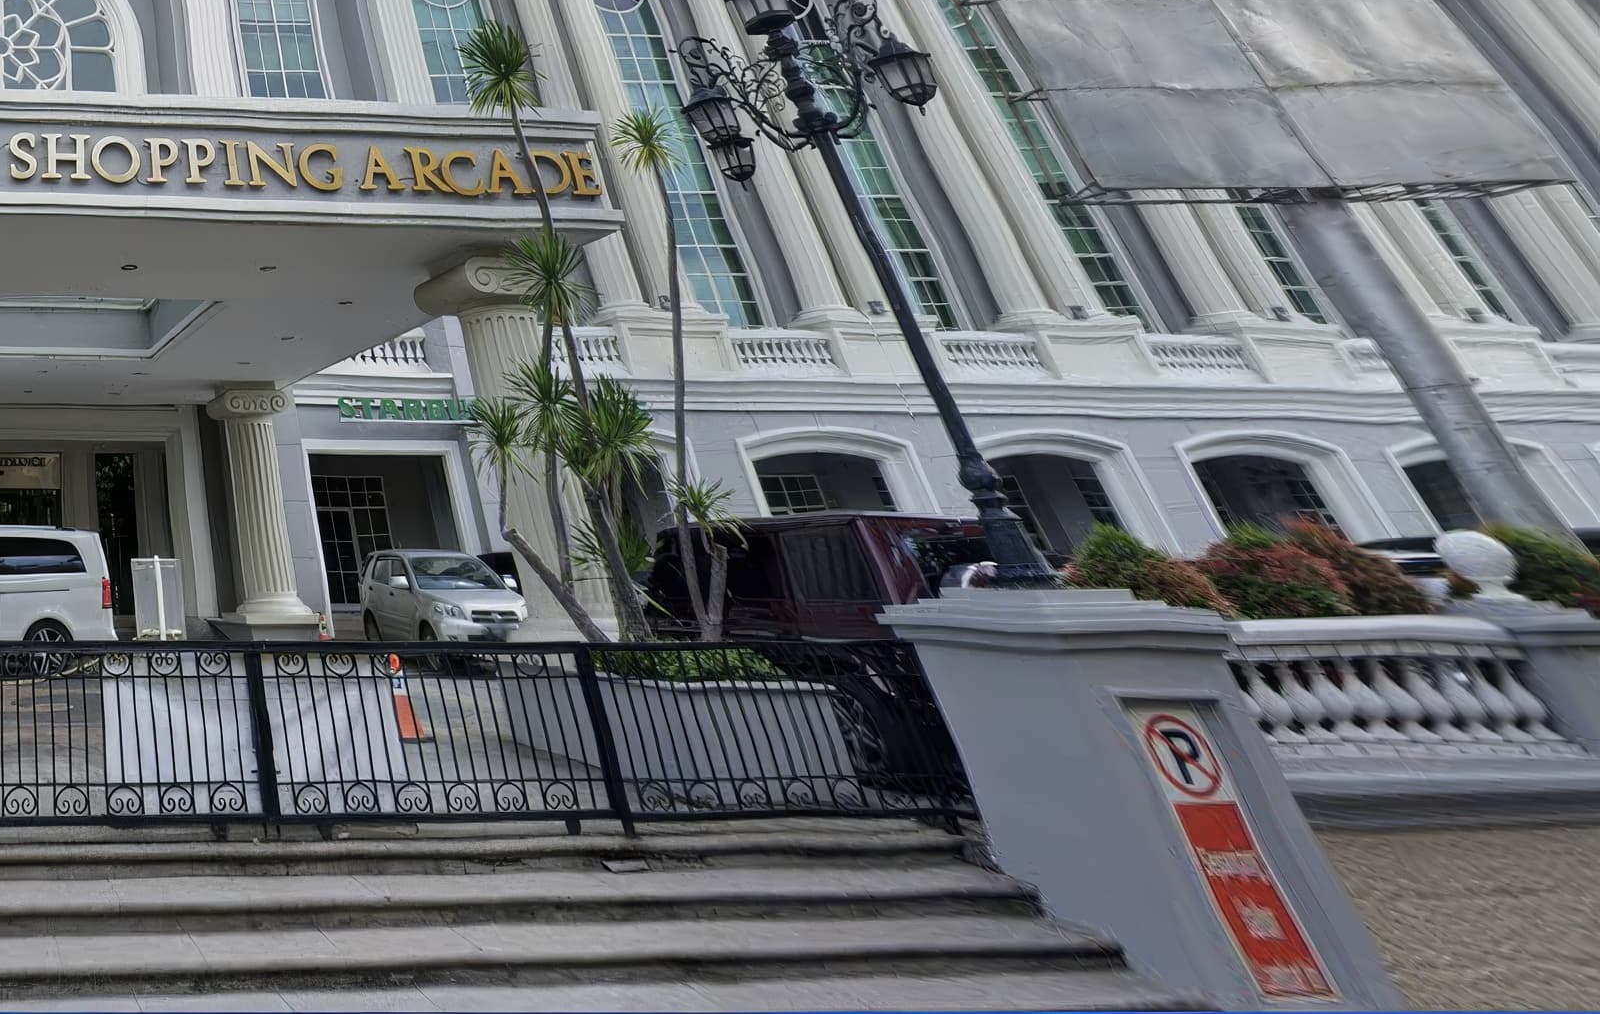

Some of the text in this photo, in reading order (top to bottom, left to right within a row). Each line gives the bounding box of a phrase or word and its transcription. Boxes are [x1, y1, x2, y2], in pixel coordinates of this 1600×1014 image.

[9, 132, 344, 192] SHOPPING
[359, 145, 603, 197] ARCADE
[338, 397, 472, 420] STARBU
[1159, 728, 1201, 785] P
